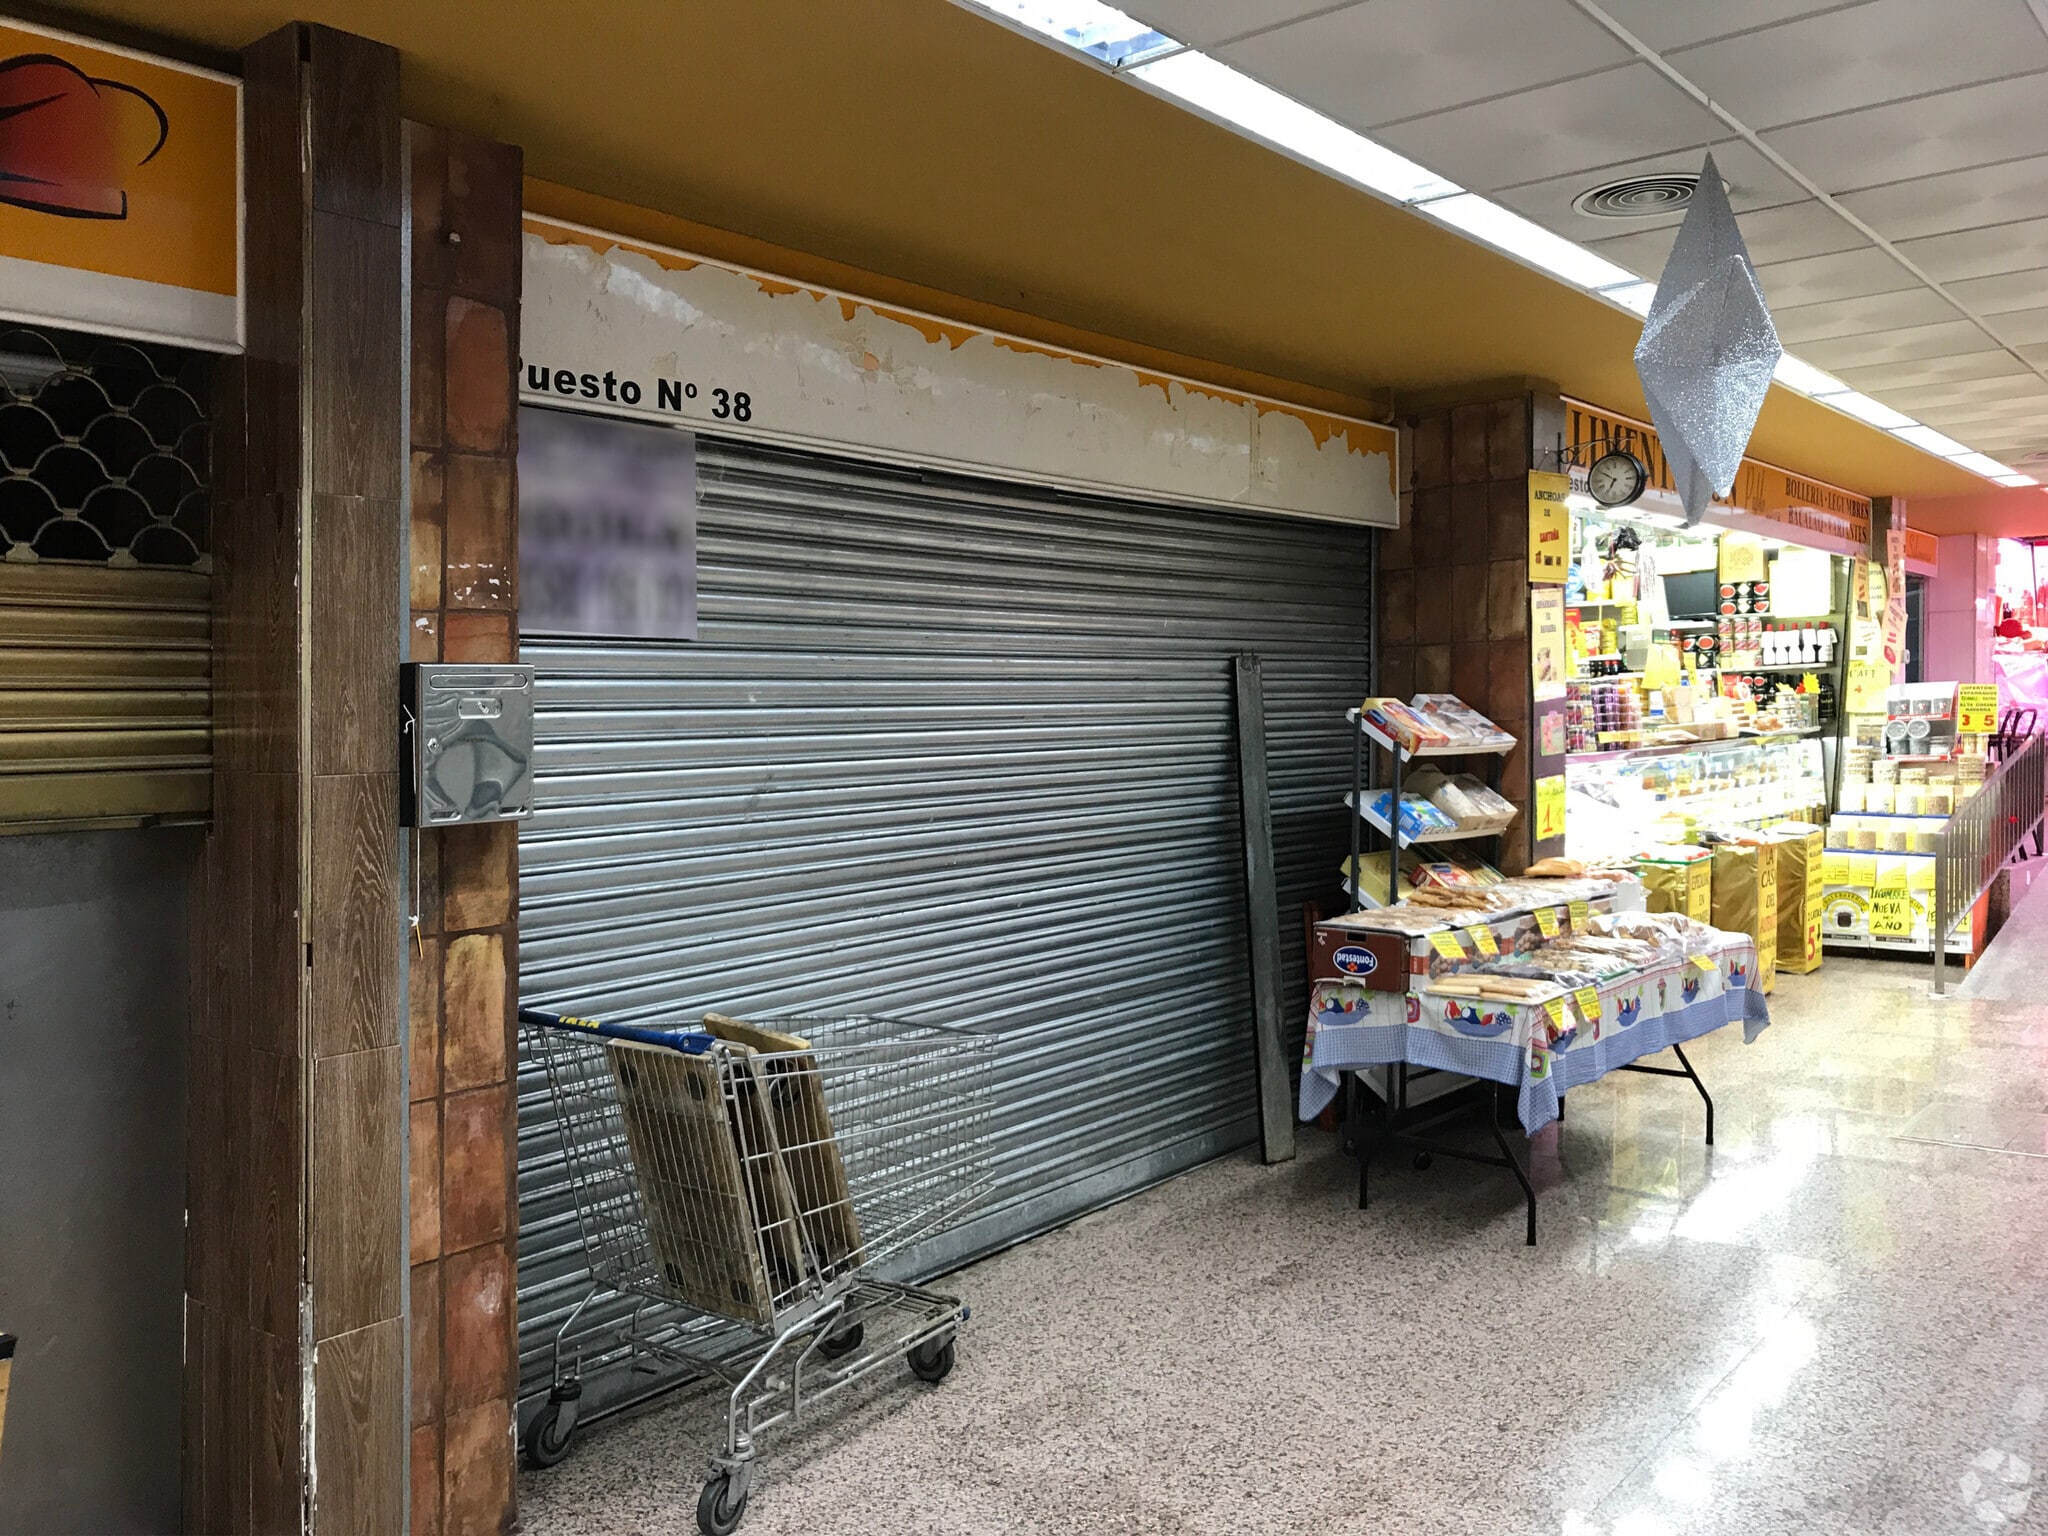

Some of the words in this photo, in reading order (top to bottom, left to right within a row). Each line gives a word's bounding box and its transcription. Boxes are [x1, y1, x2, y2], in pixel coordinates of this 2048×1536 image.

[519, 356, 641, 404] uesto
[658, 379, 698, 411] Nº
[711, 389, 751, 421] 38
[1569, 477, 1589, 494] esto
[1828, 491, 1869, 521] LEGUMBRES
[1962, 714, 1971, 726] 3
[1983, 714, 1995, 726] 5
[1872, 902, 1901, 914] NUEVA
[1808, 925, 1815, 961] 5
[1336, 952, 1374, 967] Fontestad
